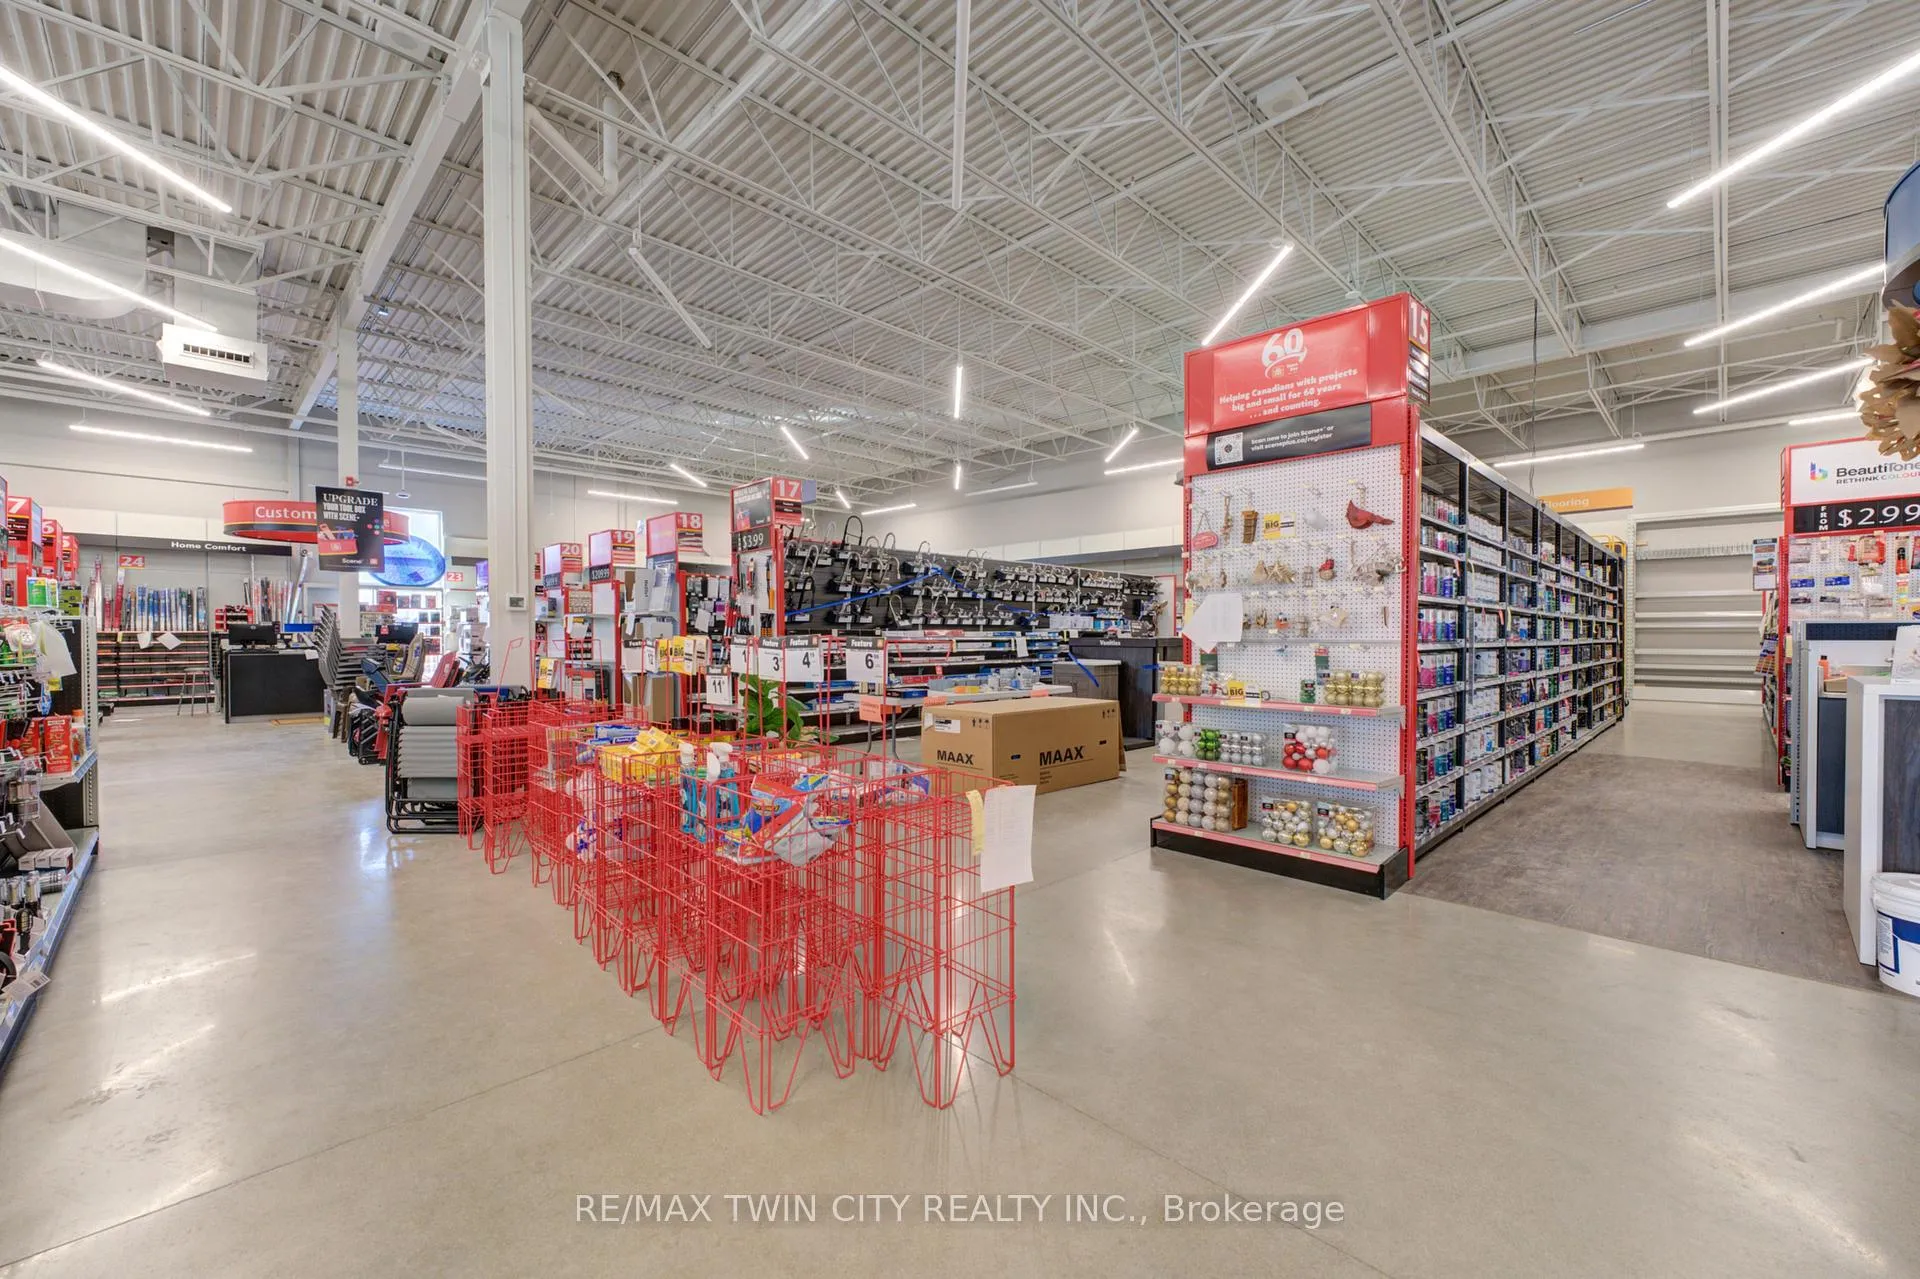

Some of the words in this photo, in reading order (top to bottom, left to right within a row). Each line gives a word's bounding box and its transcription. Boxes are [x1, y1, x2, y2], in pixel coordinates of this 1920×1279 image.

[1410, 301, 1429, 345] 15
[1261, 328, 1304, 367] 60
[1219, 391, 1251, 405] Helping
[1251, 382, 1295, 397] Canadians
[1296, 375, 1317, 388] with
[1318, 367, 1359, 385] projects
[1231, 400, 1245, 412] big
[1246, 397, 1262, 409] and
[1263, 393, 1287, 405] small
[1288, 389, 1302, 400] for
[1303, 386, 1315, 397] 60
[1316, 383, 1342, 396] years
[1251, 436, 1267, 445] Scan
[1267, 434, 1281, 442] now
[1287, 431, 1300, 441] join
[1251, 443, 1265, 451] visit
[1836, 475, 1879, 485] RETHINK
[1880, 470, 1920, 480] COLOU
[777, 479, 800, 498] 17
[322, 493, 378, 507] UPGRADE
[1544, 498, 1590, 510] looring
[255, 506, 317, 520] Custom
[322, 502, 339, 511] YOUR
[339, 503, 354, 513] TOOL
[354, 505, 366, 514] BOX
[322, 511, 339, 520] WITH
[678, 513, 702, 529] 18
[1818, 505, 1829, 531] FROM
[613, 531, 635, 544] 19
[170, 541, 201, 550] Home
[204, 543, 247, 552] Comfort
[561, 544, 581, 556] 20
[120, 556, 145, 567] 24
[447, 573, 463, 581] 23
[762, 638, 779, 649] Feature
[789, 637, 809, 647] Feature
[851, 639, 873, 648] Feature
[802, 651, 811, 669] 4
[865, 653, 874, 669] 6
[936, 750, 974, 765] MAAX
[1039, 745, 1085, 766] MAAX
